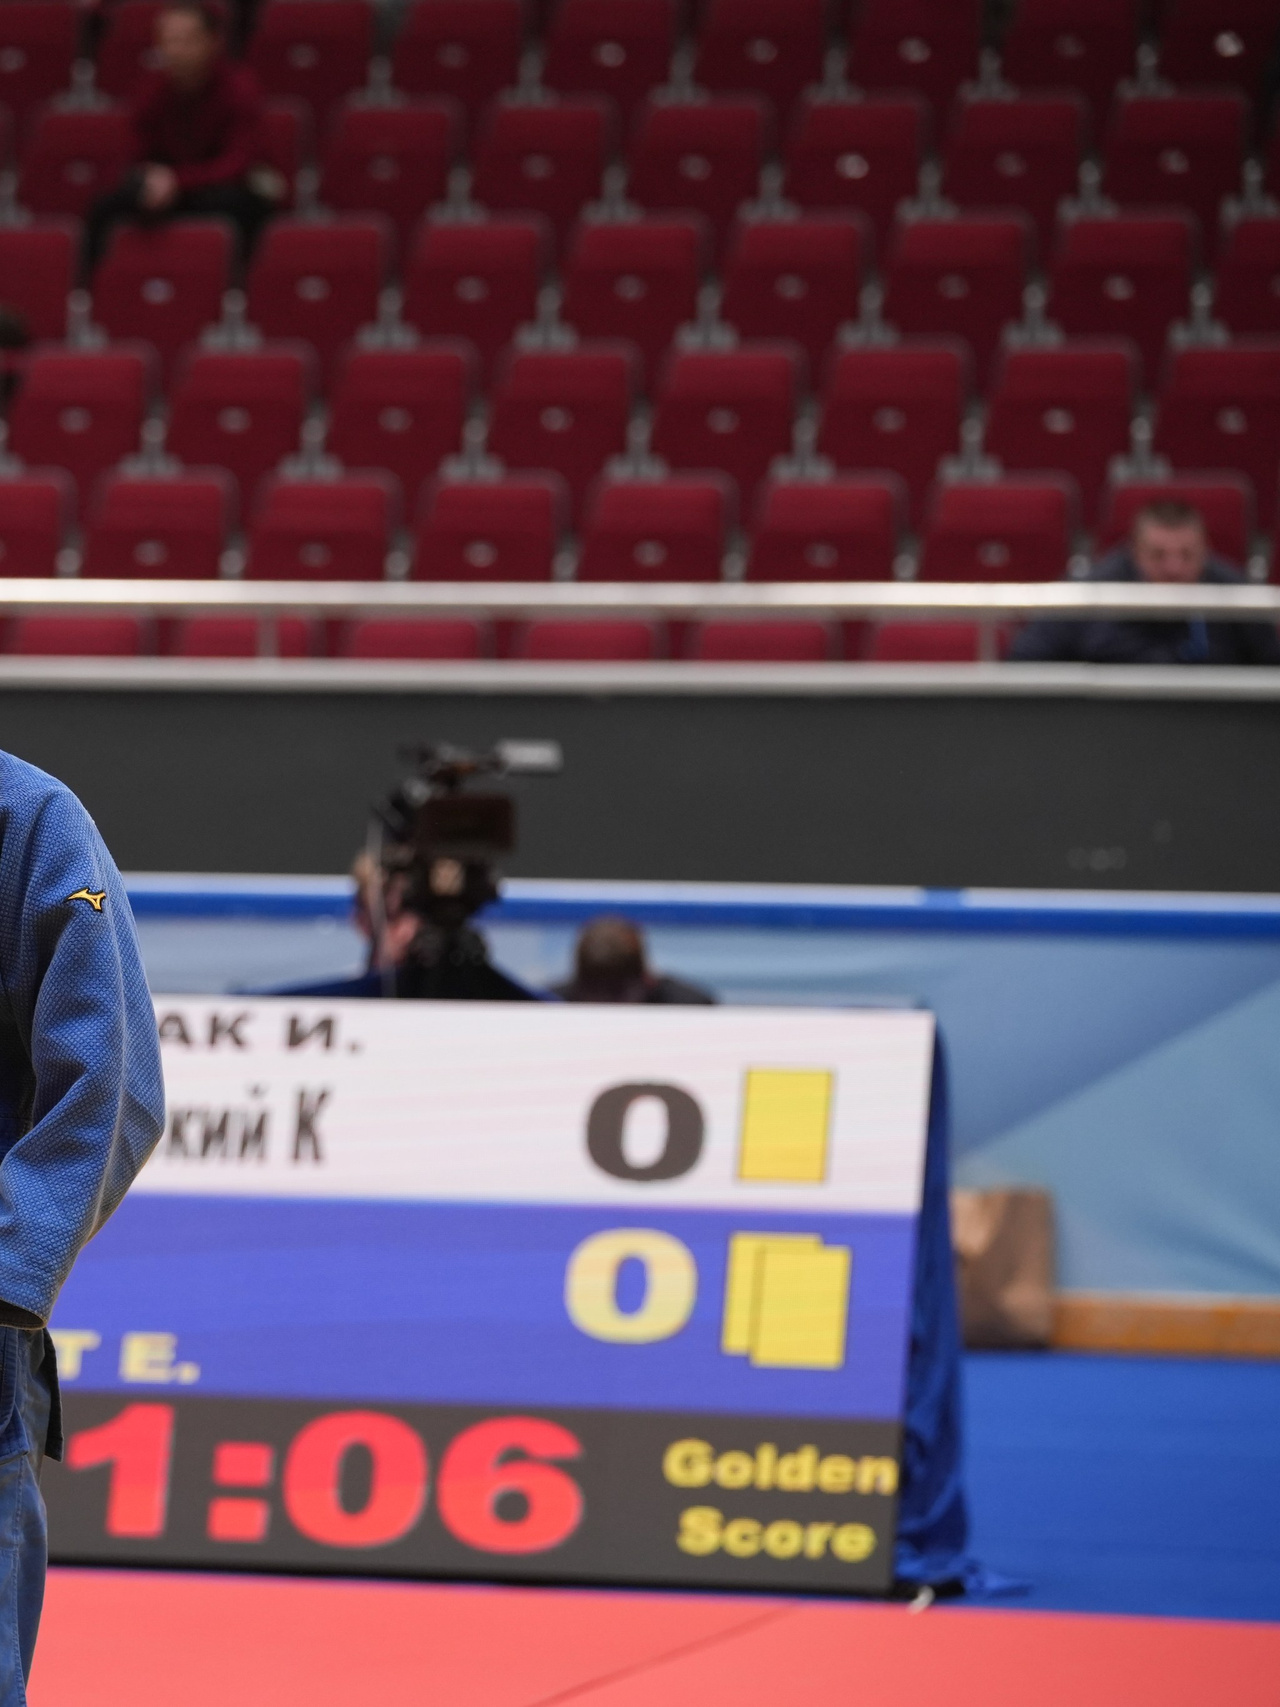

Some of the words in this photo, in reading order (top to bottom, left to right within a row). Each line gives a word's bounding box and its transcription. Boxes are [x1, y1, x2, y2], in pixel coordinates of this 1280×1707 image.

[285, 1012, 365, 1055] И.
[584, 1082, 705, 1182] 0
[564, 1227, 699, 1345] 0
[65, 1402, 584, 1554] 1:06
[662, 1437, 899, 1496] Golden
[676, 1505, 877, 1563] Score
